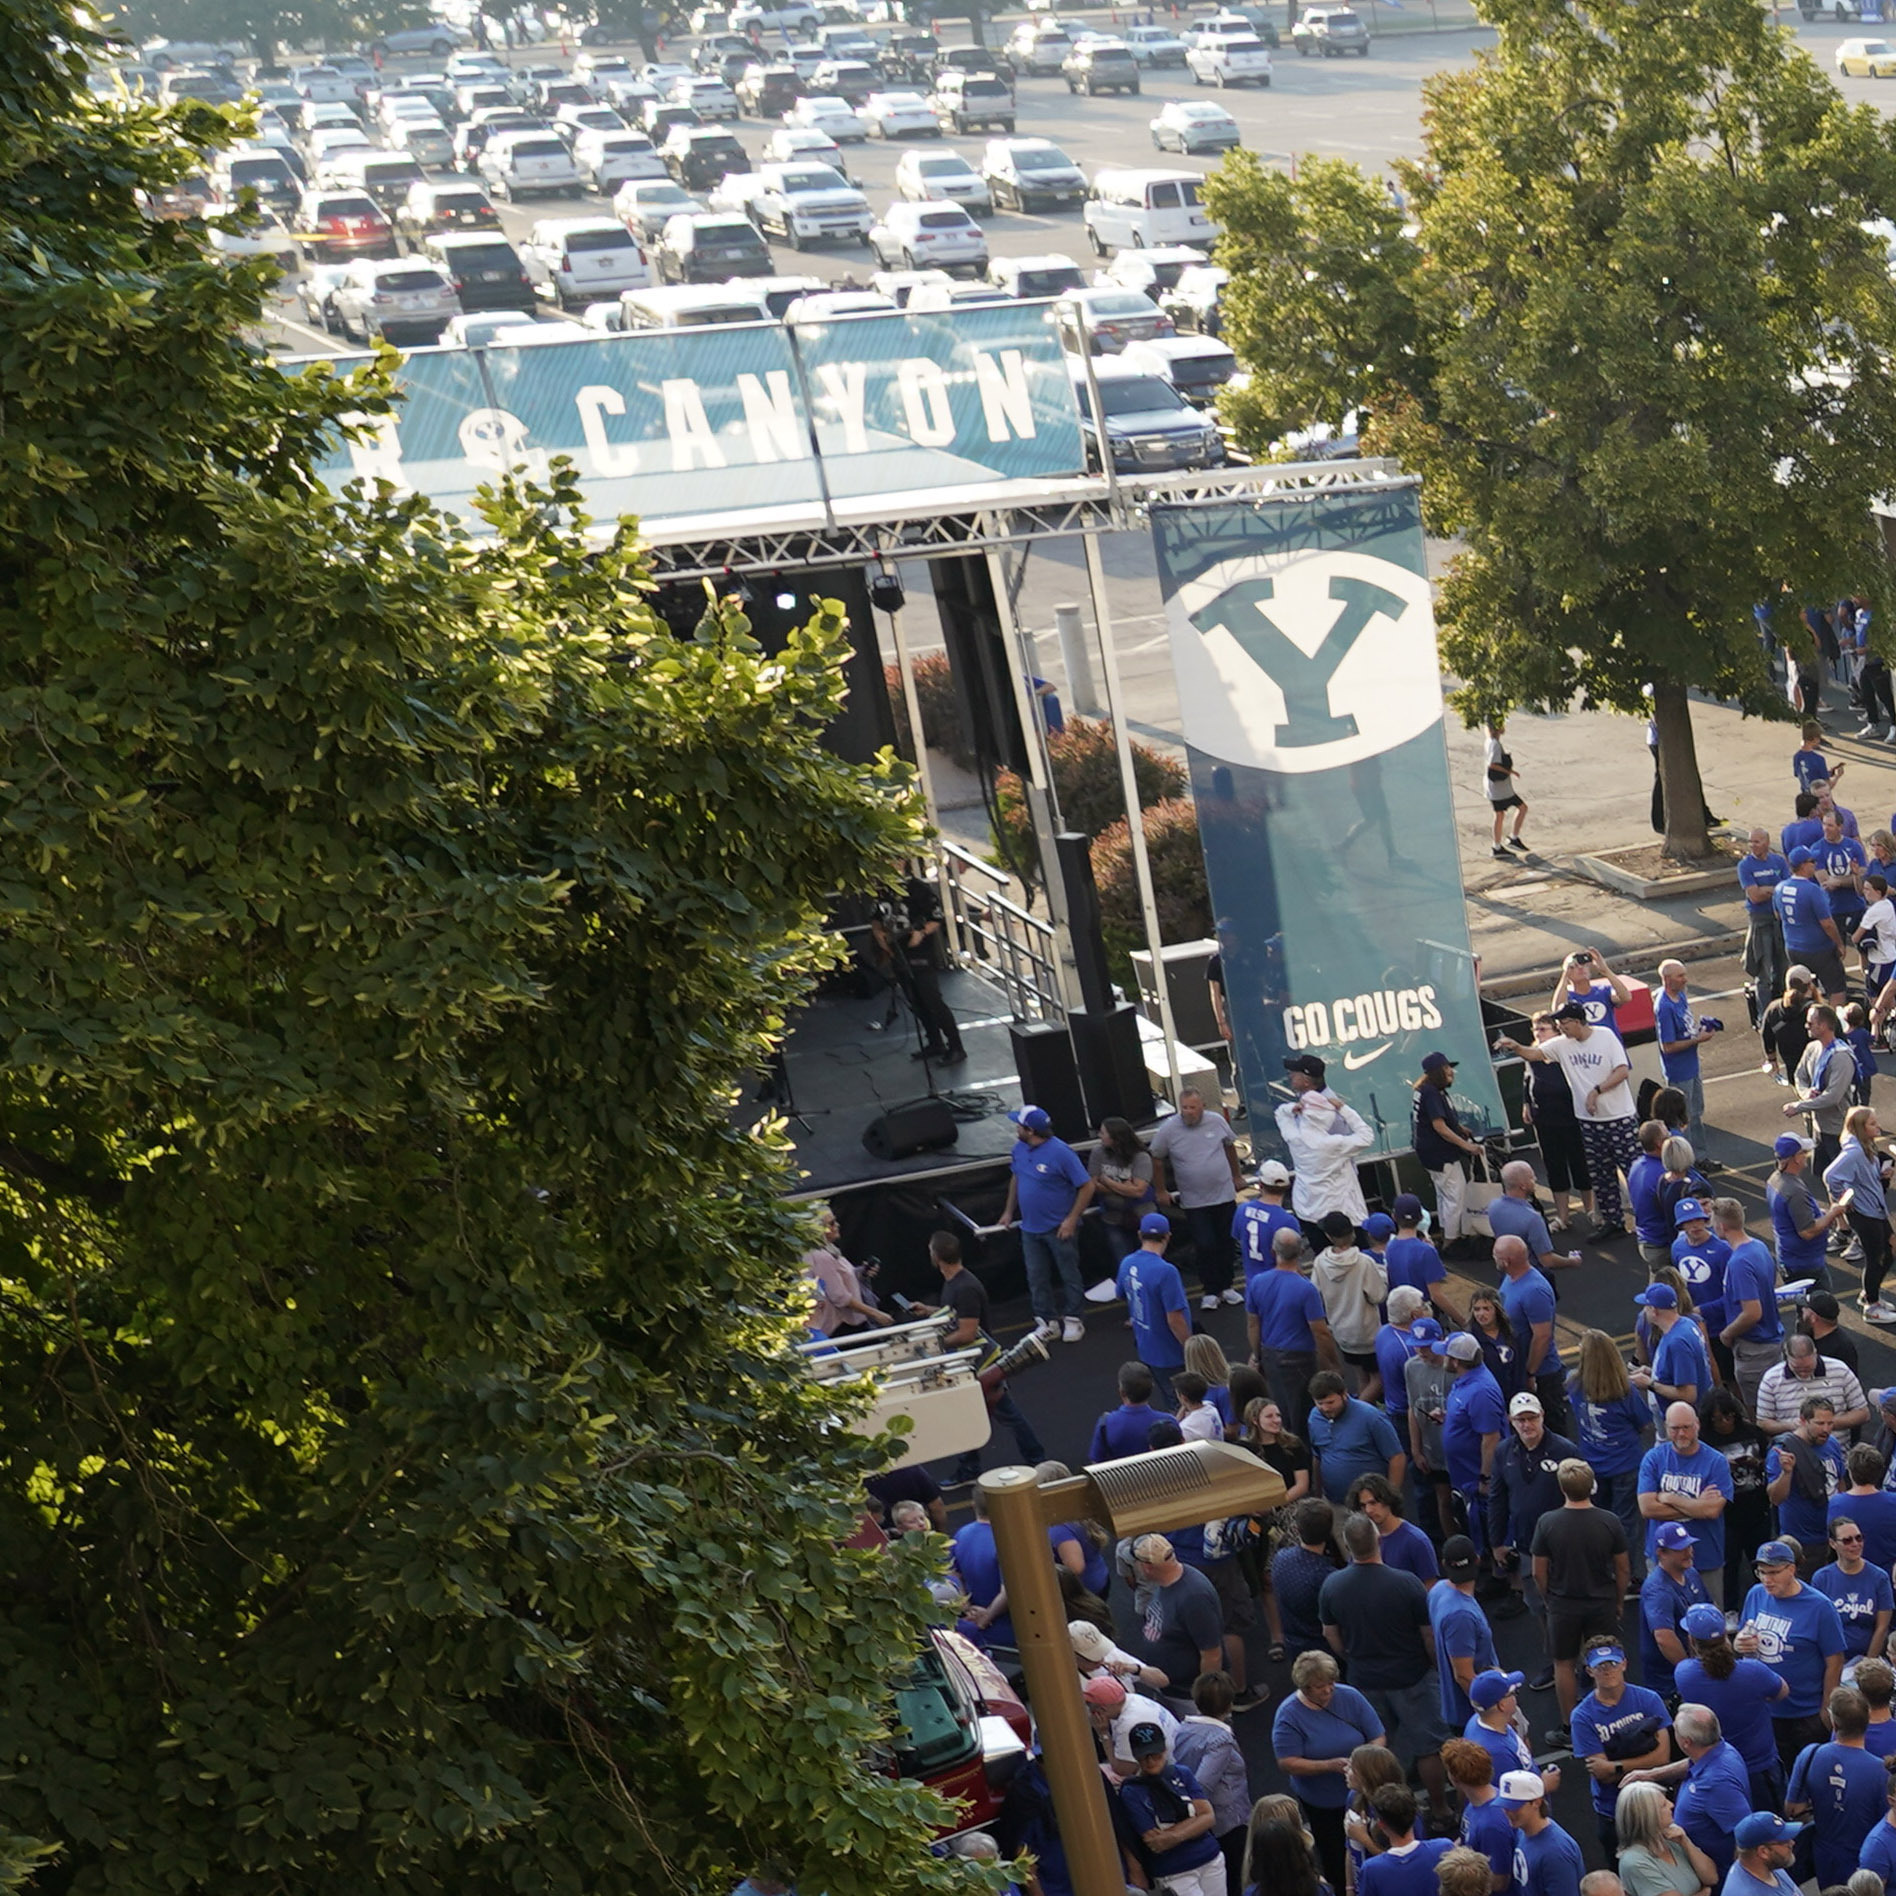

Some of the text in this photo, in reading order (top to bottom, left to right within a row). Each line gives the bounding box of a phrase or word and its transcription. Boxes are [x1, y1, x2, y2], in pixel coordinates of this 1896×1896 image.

[576, 351, 1037, 479] CANYON
[1189, 573, 1408, 748] Y
[1285, 985, 1443, 1050] GO COUGS
[1246, 1220, 1263, 1261] 1
[1660, 1473, 1702, 1499] FOOTBALL
[1834, 1598, 1874, 1620] Loyal
